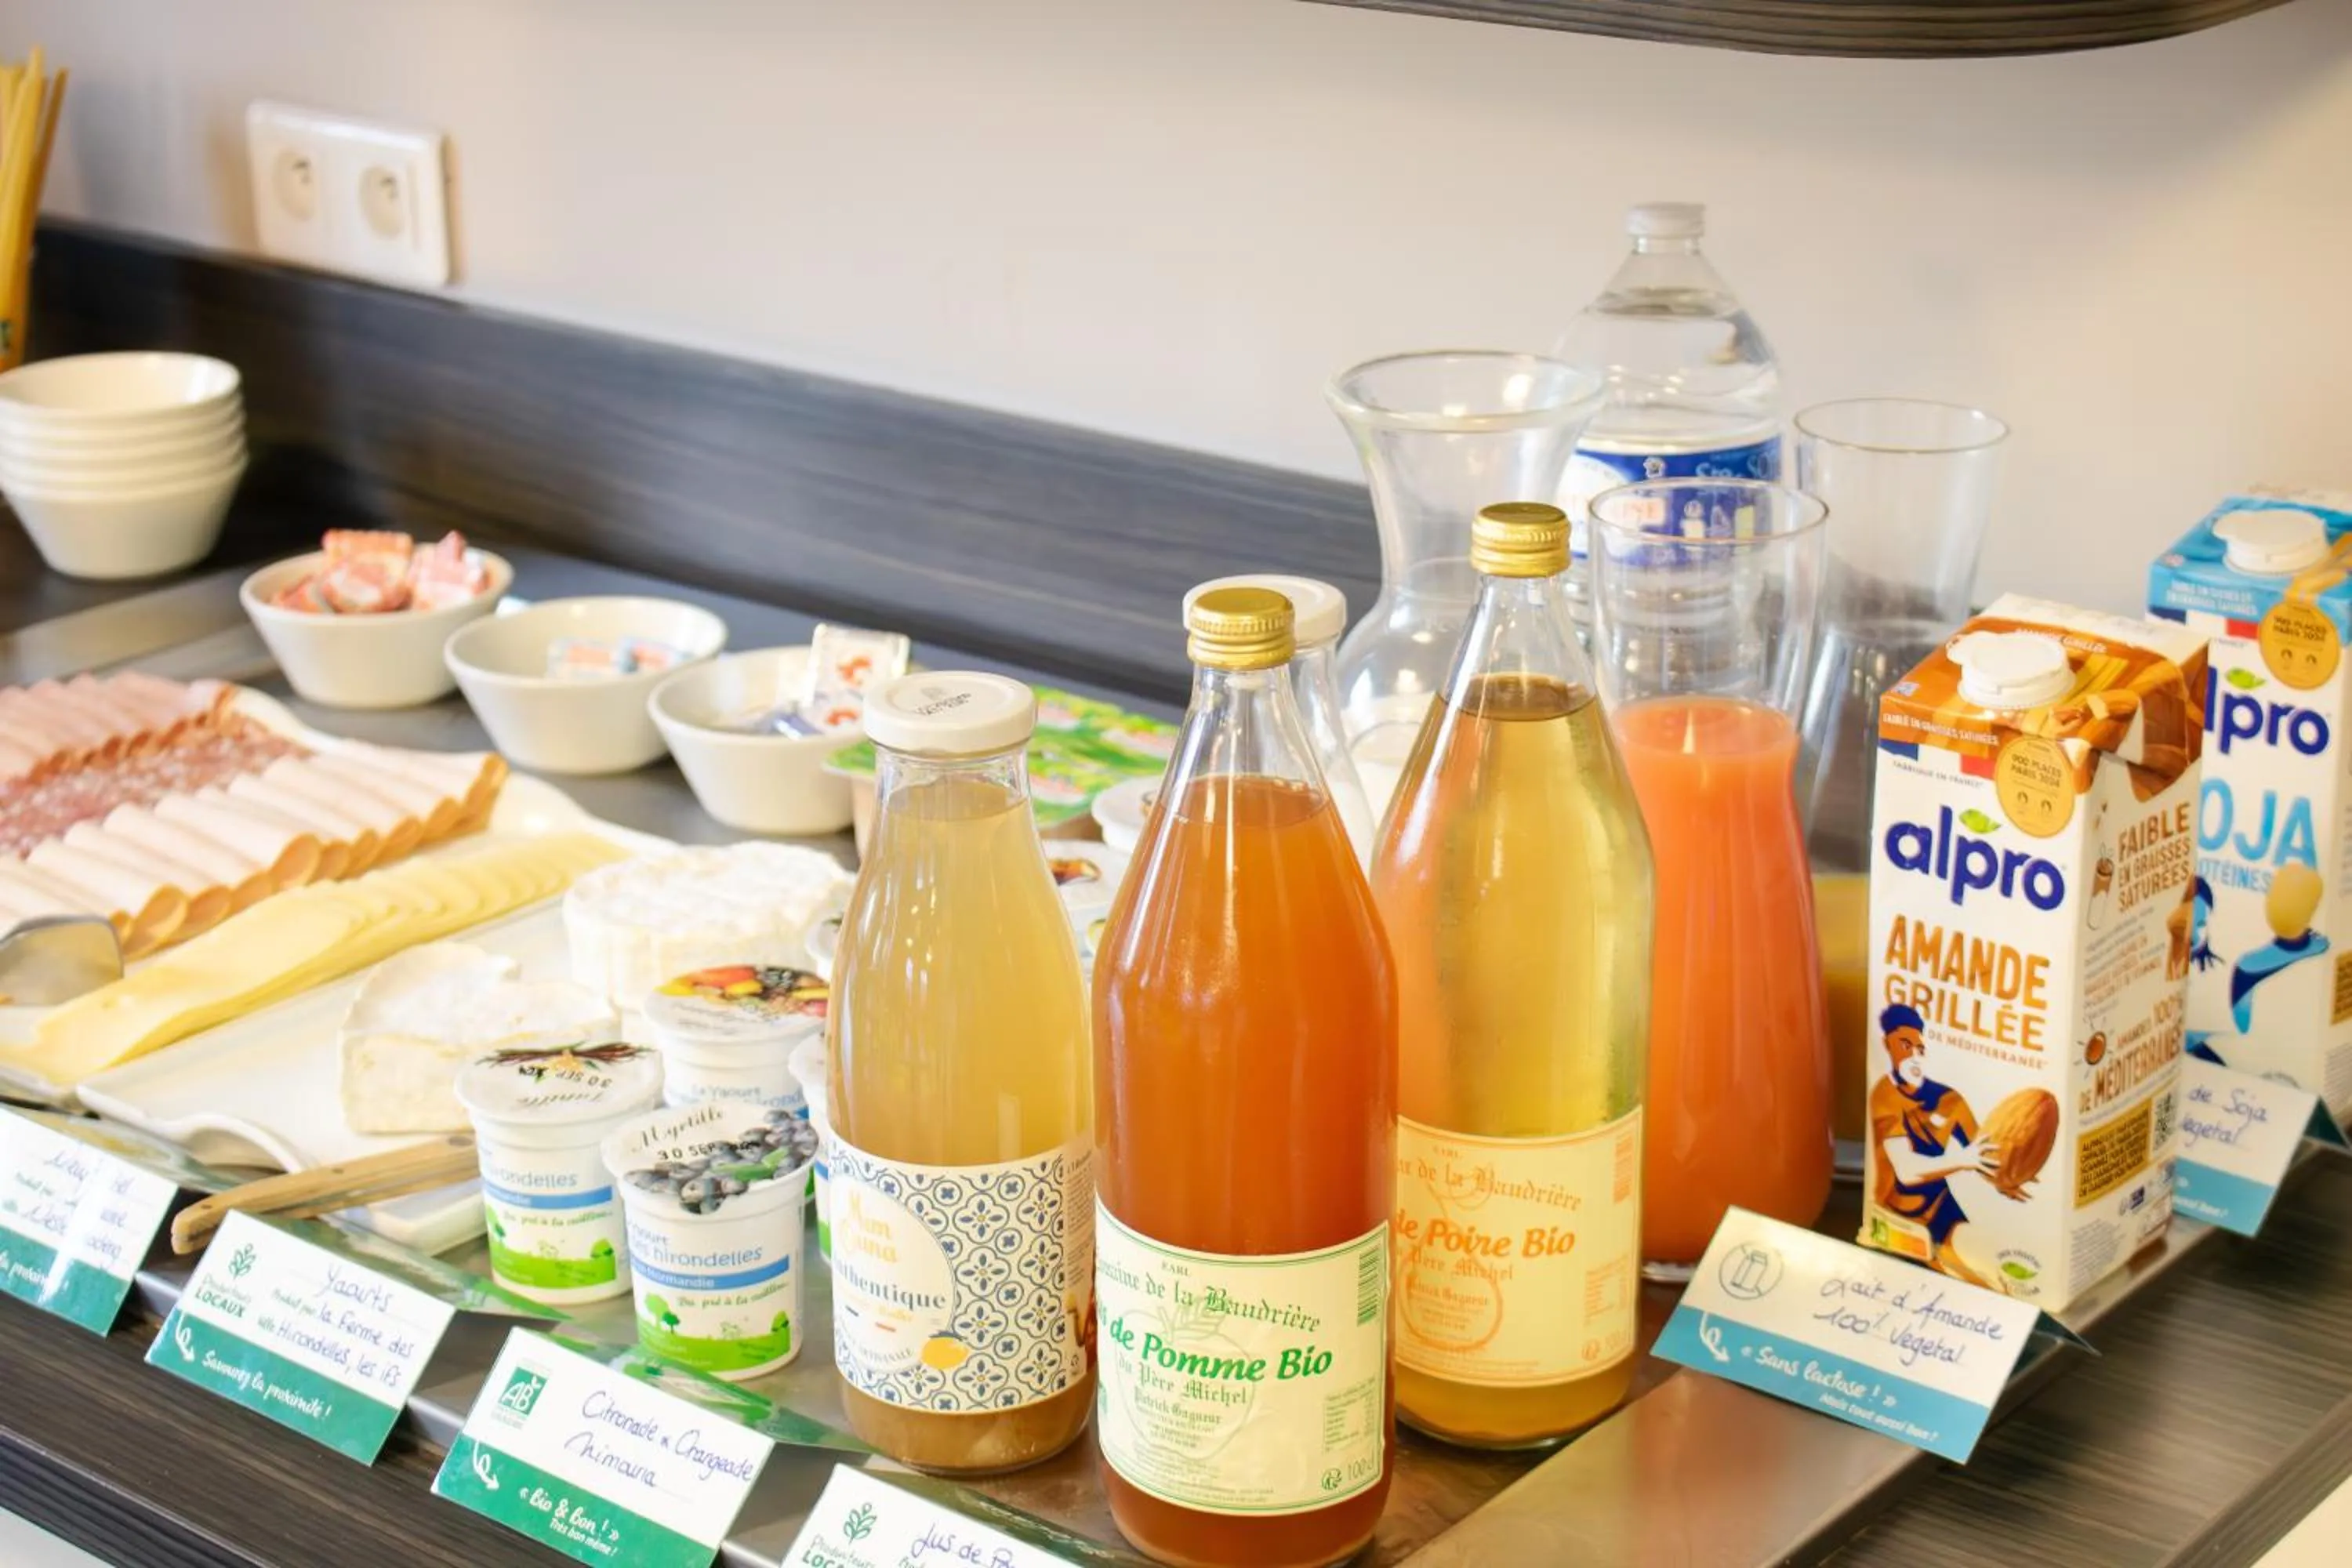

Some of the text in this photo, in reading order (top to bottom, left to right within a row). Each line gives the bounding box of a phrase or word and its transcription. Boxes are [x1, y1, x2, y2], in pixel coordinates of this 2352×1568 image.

[2204, 665, 2330, 757] lpro
[2119, 800, 2190, 862] FAIBLE
[2198, 779, 2318, 870] OJA
[1885, 804, 2066, 911] alpro
[2119, 837, 2190, 887] EN GRAISSES
[2198, 856, 2273, 895] OTÉINES
[2118, 860, 2190, 913] SATURÉES
[1885, 913, 2050, 1010] AMANDE
[1885, 973, 2046, 1052] GRILLÉE
[1928, 1029, 1943, 1041] DE
[657, 1149, 683, 1161] 30
[653, 1245, 762, 1268] hirondelles
[1427, 1218, 1513, 1258] Poire
[1522, 1225, 1576, 1259] Bio
[195, 1287, 245, 1319] LOCAUX
[313, 1263, 394, 1312] Yaourts
[1145, 1272, 1166, 1299] de
[1174, 1280, 1195, 1306] la
[1204, 1284, 1321, 1334] Baudrière
[317, 1302, 332, 1324] la
[389, 1339, 416, 1359] des
[1109, 1316, 1135, 1352] de
[1142, 1333, 1267, 1383] Pomme
[1276, 1345, 1333, 1381] Bio
[201, 1350, 250, 1391] Savourez
[250, 1370, 264, 1392] la
[263, 1383, 325, 1418] proximité
[501, 1381, 535, 1410] AB
[1181, 1380, 1247, 1406] Michel
[1755, 1345, 1799, 1377] Sans
[1803, 1360, 1867, 1399] lactose
[582, 1390, 659, 1442] Citronade
[530, 1487, 552, 1512] Bio
[554, 1497, 569, 1519] &
[550, 1517, 568, 1534] Très
[567, 1526, 586, 1542] bon
[911, 1523, 956, 1559] Jus
[959, 1542, 982, 1564] de
